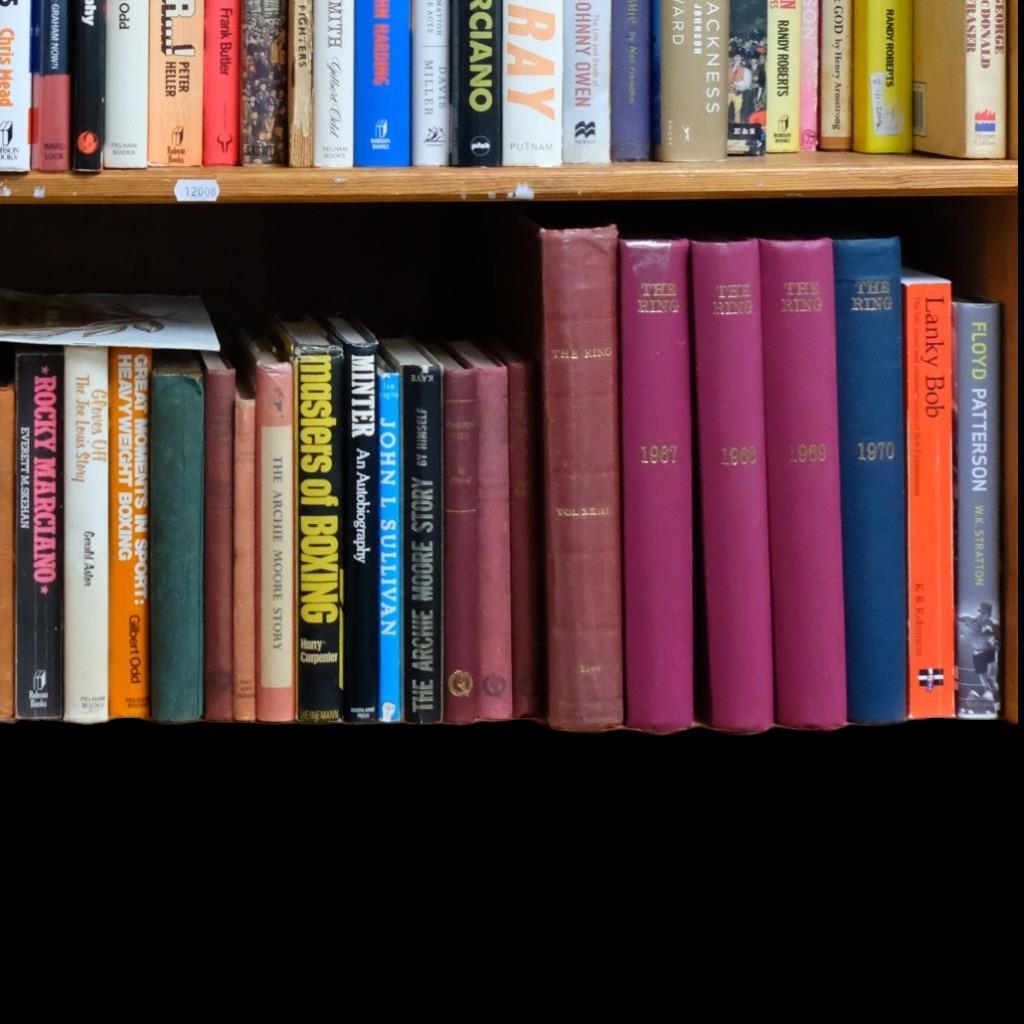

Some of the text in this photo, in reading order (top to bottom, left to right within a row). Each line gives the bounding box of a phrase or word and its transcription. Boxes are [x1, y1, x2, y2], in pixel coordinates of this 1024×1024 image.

[119, 2, 130, 30] Odd
[506, 3, 557, 121] RAY
[884, 9, 895, 88] RANDY ROBERTS
[165, 61, 177, 98] HELLER
[178, 62, 190, 93] PETER
[510, 142, 554, 151] PUTNAM
[640, 282, 677, 296] THE
[854, 280, 890, 295] THE
[637, 298, 680, 313] RING
[851, 297, 893, 311] RING
[924, 296, 946, 419] Lanky Bob
[971, 321, 988, 492] FLOYD PATTERSON
[351, 354, 376, 564] MINTER An Autobiography
[640, 445, 679, 464] 1967
[857, 442, 895, 461] 1970
[300, 355, 339, 624] masters of BOXING
[380, 417, 397, 637] JOHN L SULLIVAN
[411, 477, 434, 713] THE ARCHIE MOORE STORY
[300, 638, 326, 652] Harry
[300, 651, 339, 665] Carpenter
